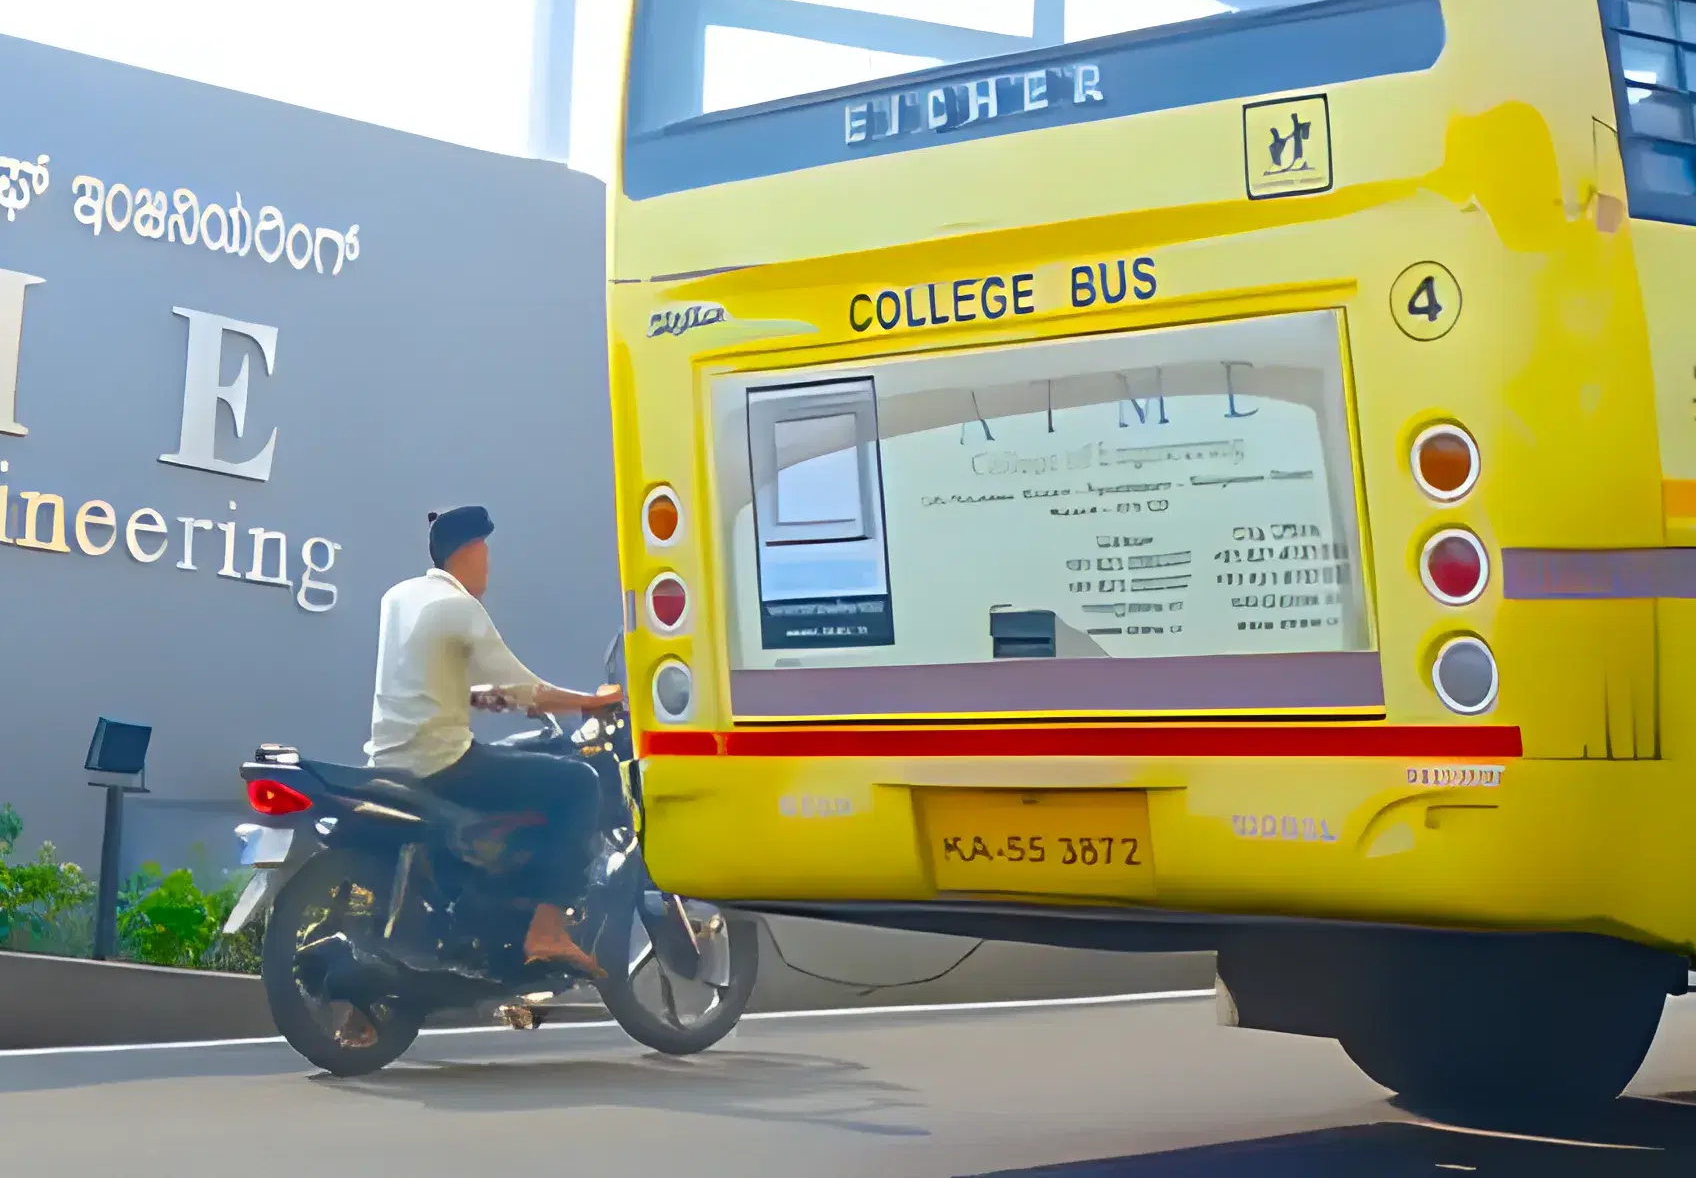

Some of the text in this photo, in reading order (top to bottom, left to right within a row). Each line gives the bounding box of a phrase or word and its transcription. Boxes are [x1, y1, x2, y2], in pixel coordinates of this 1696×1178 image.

[849, 257, 1157, 332] COLLEGE BUS
[1407, 275, 1443, 322] 4
[1057, 836, 1143, 866] 3872
